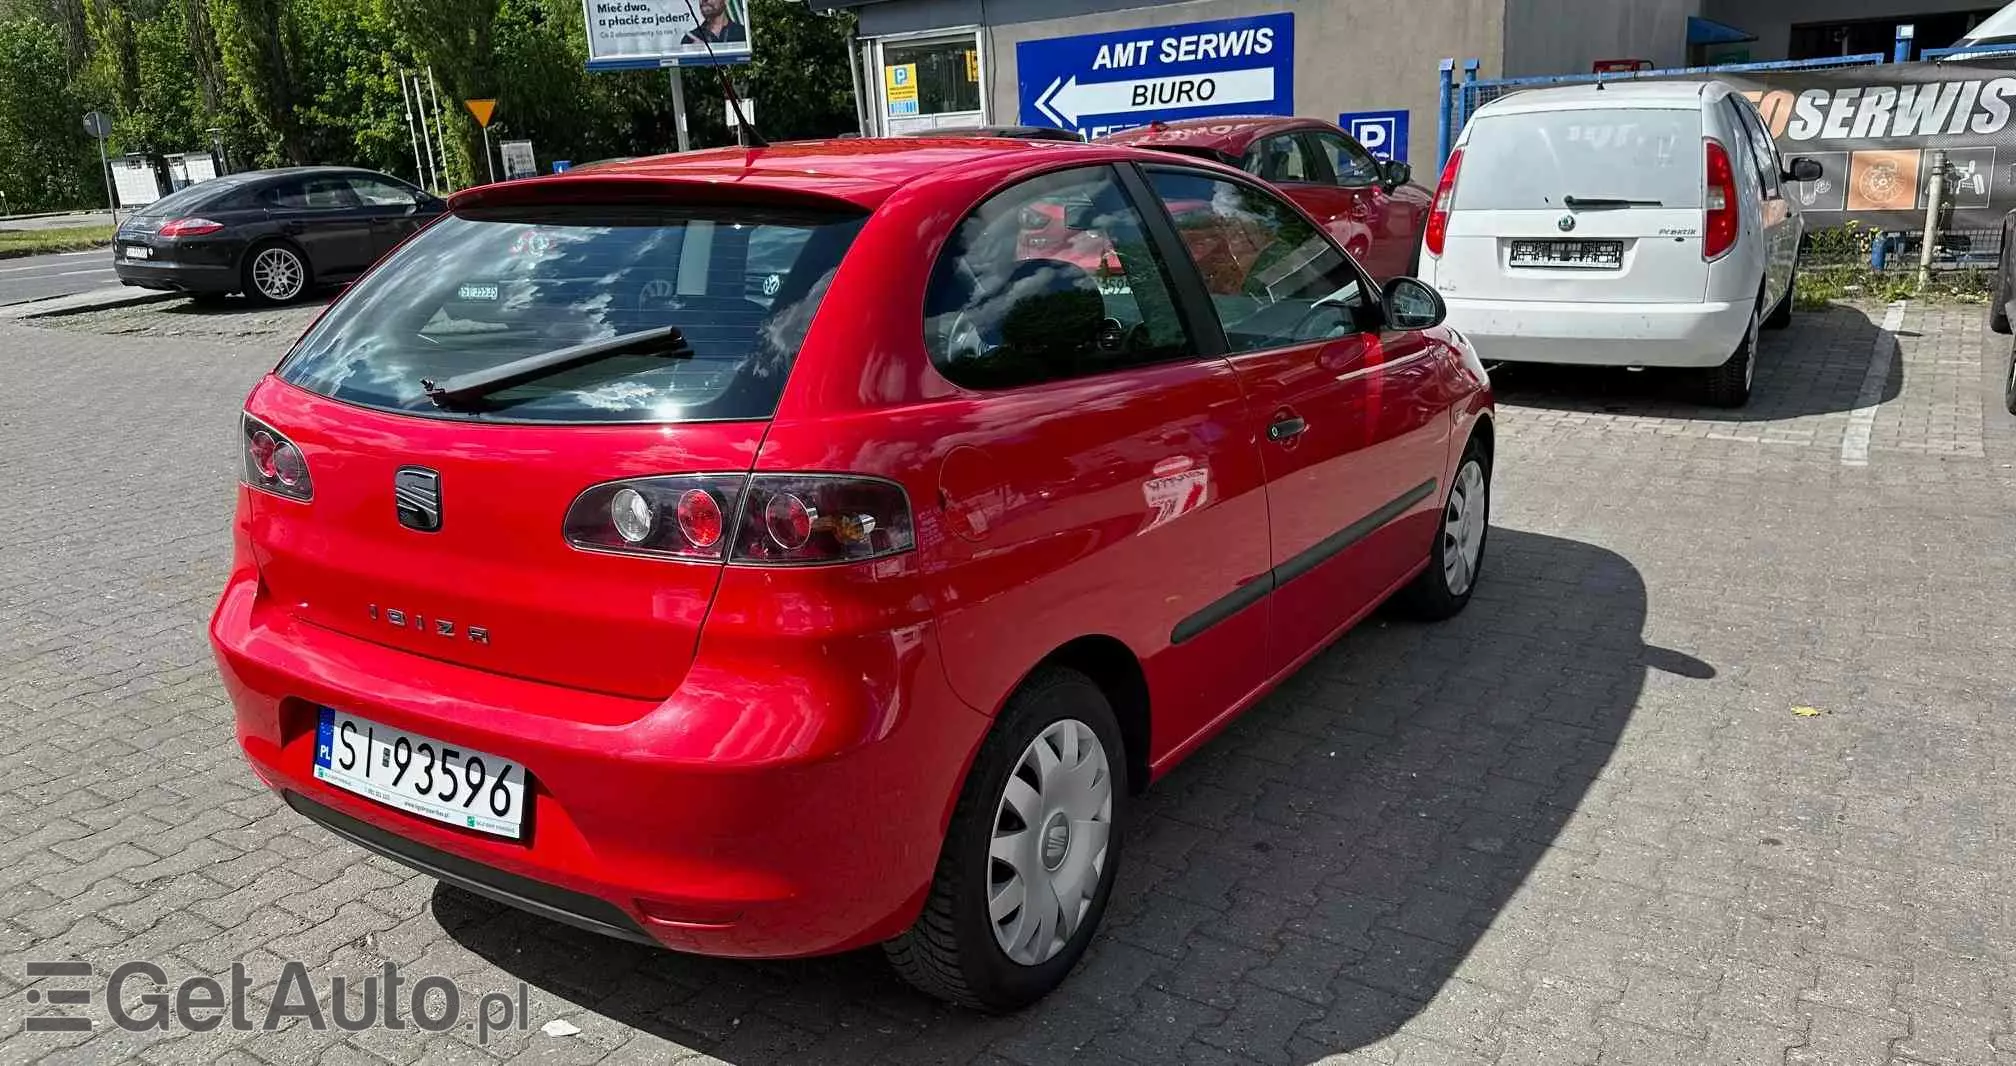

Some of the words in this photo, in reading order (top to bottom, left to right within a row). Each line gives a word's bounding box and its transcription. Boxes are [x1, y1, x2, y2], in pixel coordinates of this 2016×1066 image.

[597, 3, 622, 13] Mieć
[624, 2, 650, 12] dwa,
[608, 14, 639, 28] płacić
[641, 16, 654, 25] za
[655, 12, 690, 26] jeden?
[1092, 40, 1153, 70] AMT
[1159, 28, 1274, 63] SERWIS
[1131, 78, 1216, 107] BIURO
[1360, 124, 1386, 150] P
[368, 603, 490, 644] IBIZA
[320, 744, 331, 761] PL
[338, 720, 373, 778] SI
[392, 736, 513, 817] 93596
